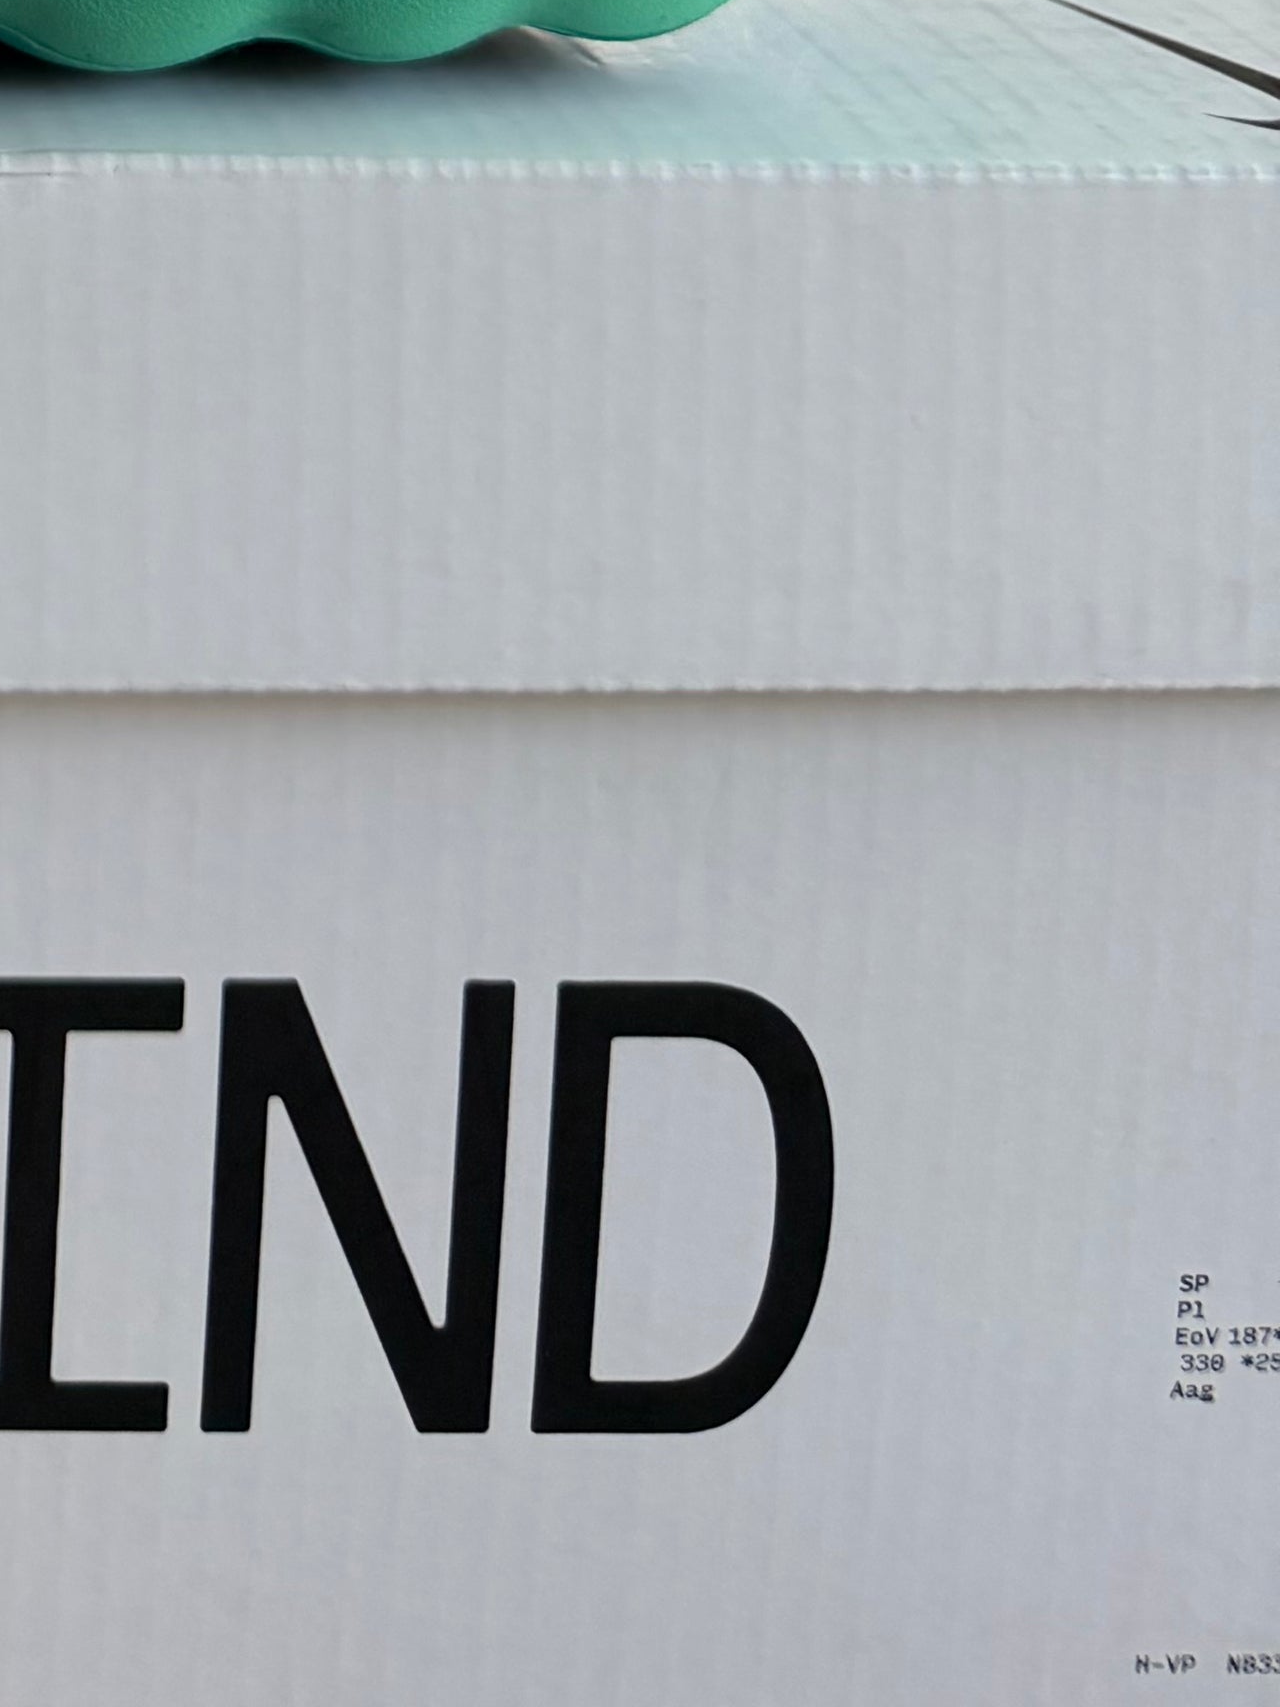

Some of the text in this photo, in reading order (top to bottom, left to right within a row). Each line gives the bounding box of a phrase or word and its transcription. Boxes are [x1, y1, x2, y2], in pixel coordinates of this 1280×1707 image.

[1179, 1274, 1210, 1293] SP
[1177, 1300, 1205, 1319] P1
[1175, 1327, 1220, 1345] EoV
[1180, 1354, 1225, 1373] 330
[1169, 1380, 1214, 1402] Aag
